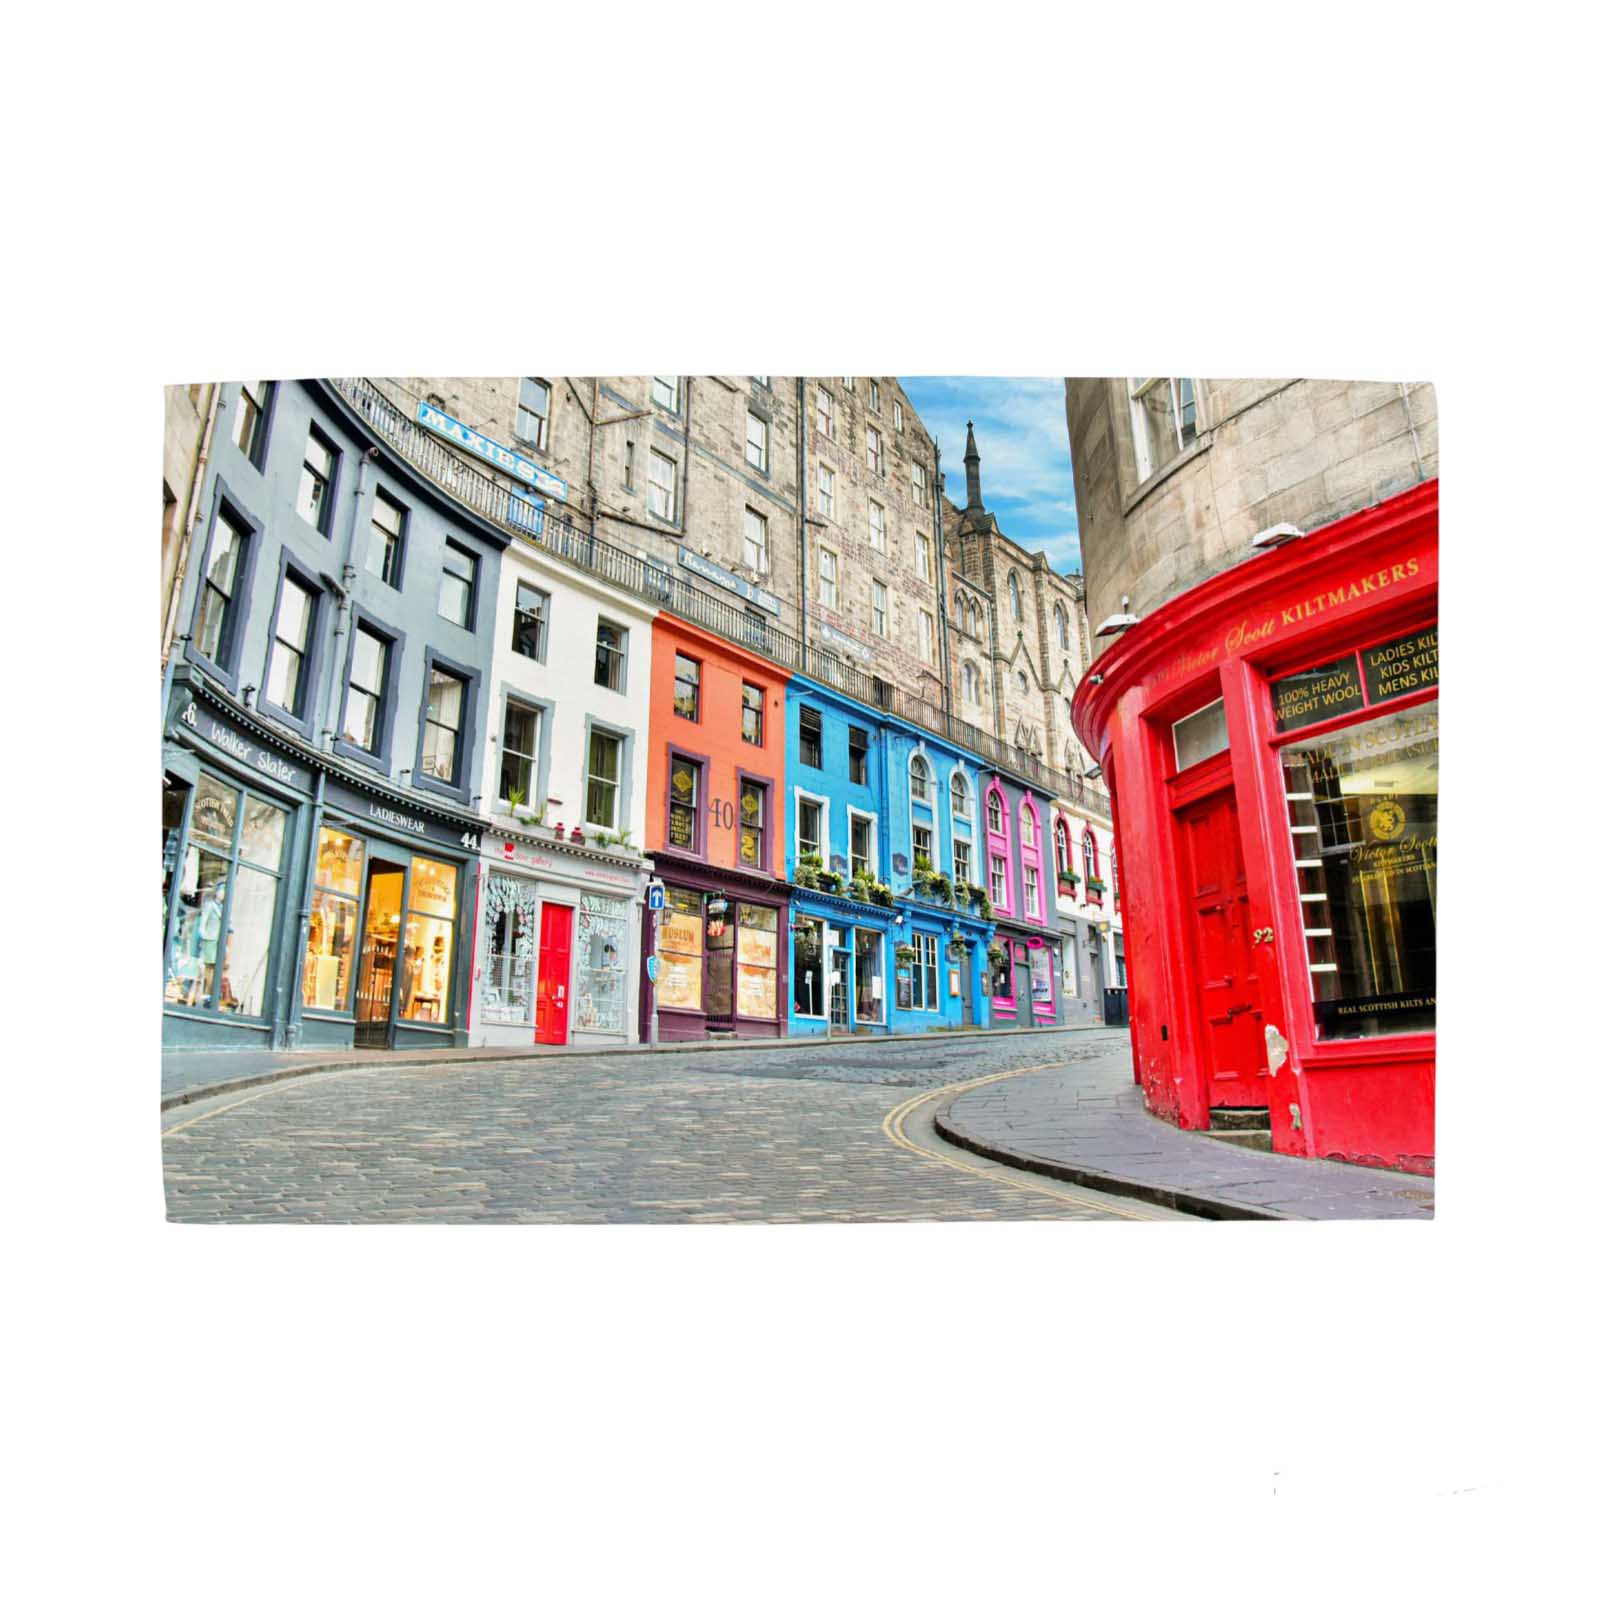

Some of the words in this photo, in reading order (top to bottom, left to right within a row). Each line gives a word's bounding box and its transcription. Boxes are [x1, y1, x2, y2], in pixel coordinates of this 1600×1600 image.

[1224, 619, 1276, 657] Scott
[1281, 557, 1419, 626] KILTMAKERS
[1370, 641, 1415, 667] LADIES
[1379, 660, 1410, 680] KIDS
[1278, 686, 1310, 706] 100%
[1312, 672, 1351, 695] HEAVY
[1378, 675, 1418, 697] MENS
[1275, 697, 1320, 721] WEIGHT
[1322, 685, 1361, 706] WOOL
[211, 722, 251, 761] Walker
[257, 750, 297, 782] Slater
[369, 803, 426, 834] LADIESWEAR
[708, 797, 734, 831] 40
[1253, 926, 1274, 945] 92
[1338, 1005, 1358, 1015] REAL
[1360, 1001, 1398, 1014] SCOTTISH
[1400, 998, 1423, 1010] KILTS
